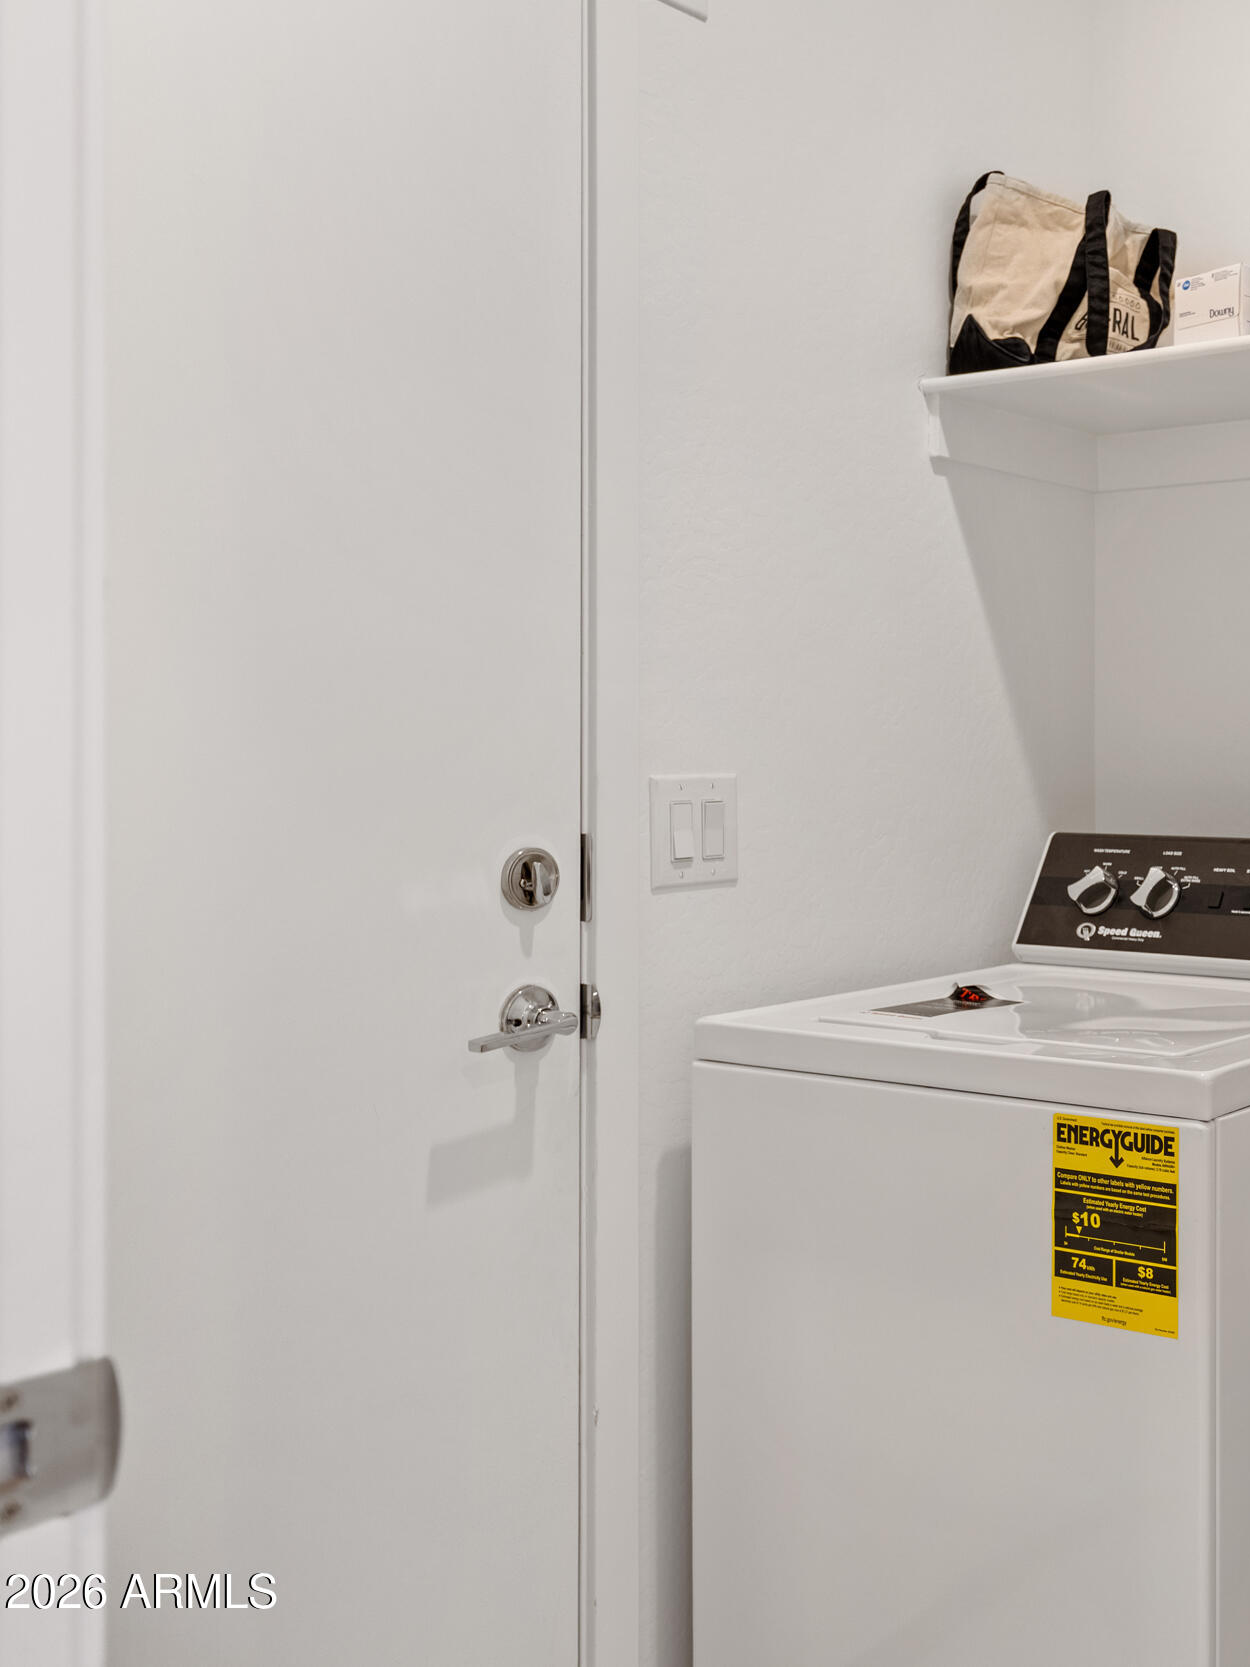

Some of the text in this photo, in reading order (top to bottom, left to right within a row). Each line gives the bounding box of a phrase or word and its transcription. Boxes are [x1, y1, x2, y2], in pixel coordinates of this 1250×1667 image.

[1209, 306, 1235, 319] Downy
[1097, 925, 1129, 937] Speed
[1056, 1122, 1175, 1158] ENERGYGUIDE
[1057, 1171, 1077, 1180] Compare
[1135, 1183, 1151, 1191] yellow
[1082, 1197, 1147, 1213] Estimated Yearly Energy Cost
[1071, 1210, 1101, 1229] $10
[1071, 1256, 1087, 1270] 74
[1137, 1266, 1154, 1280] $8
